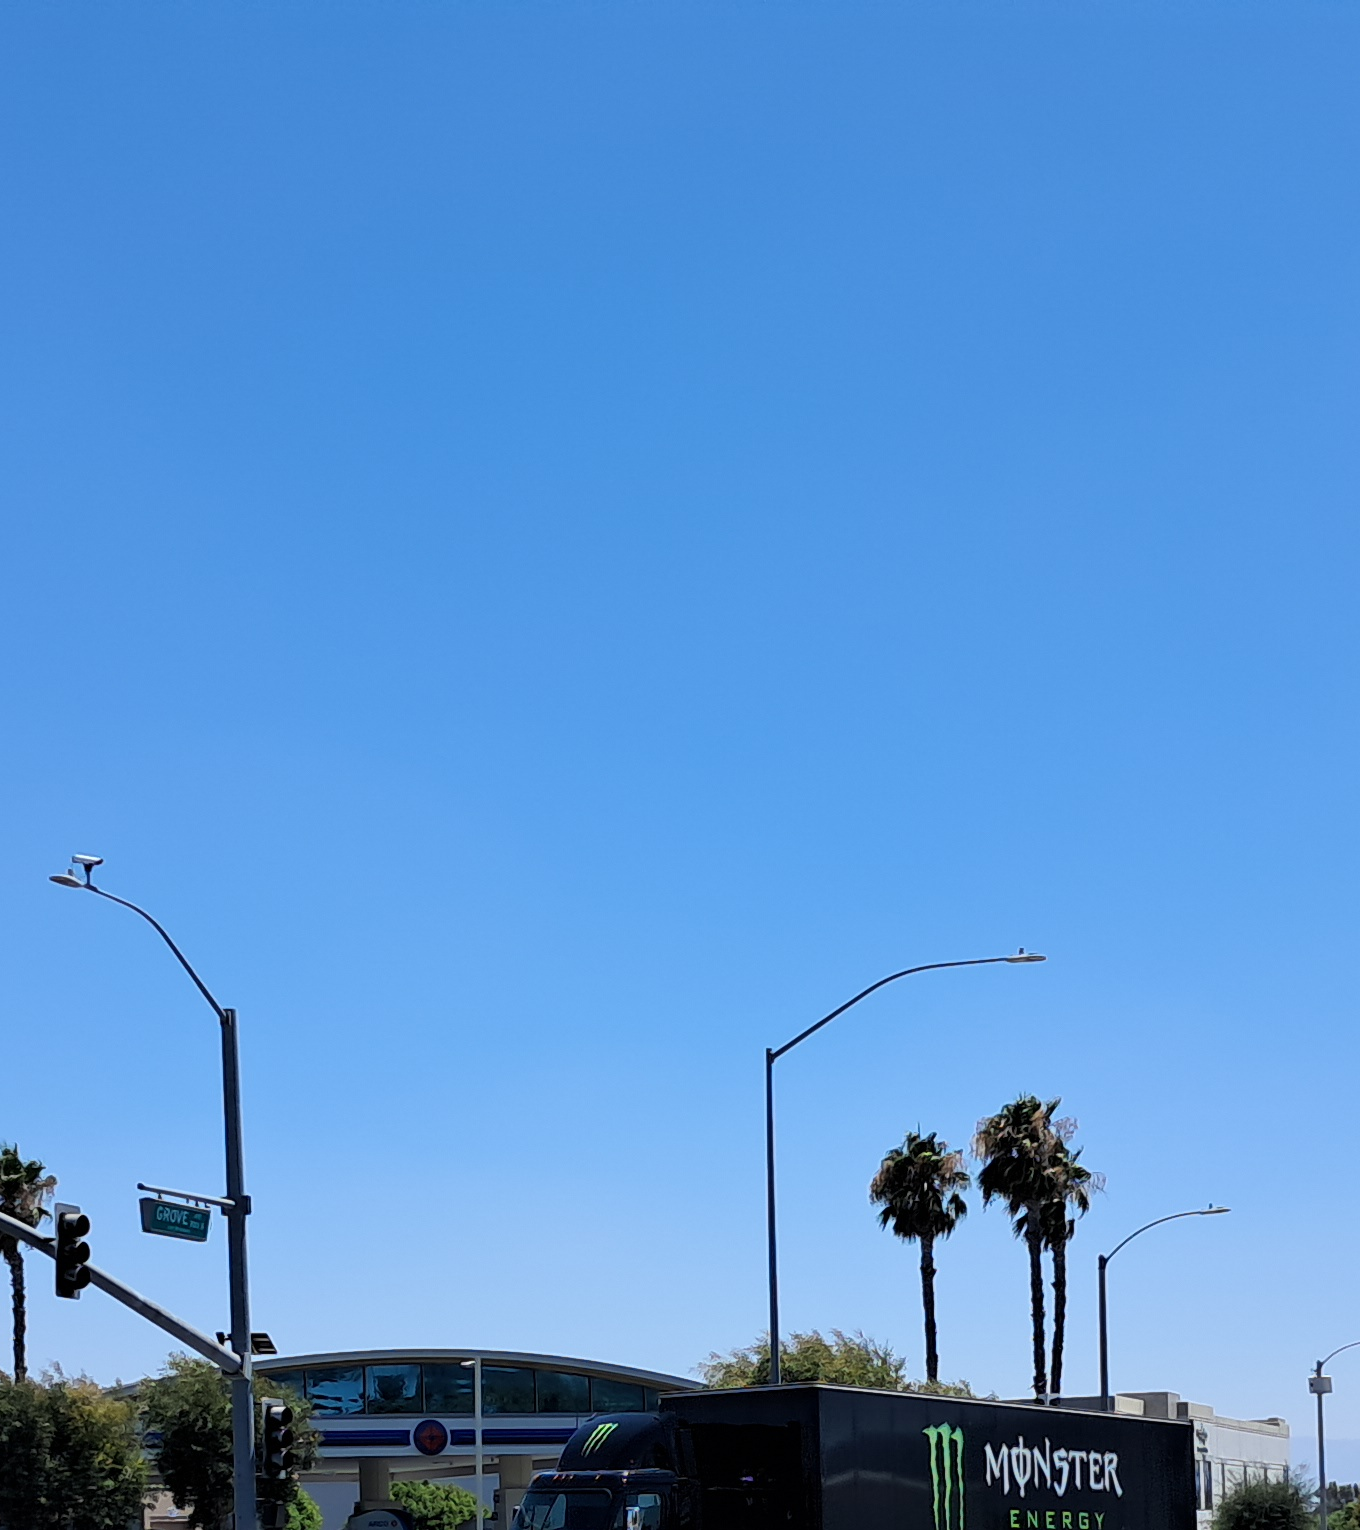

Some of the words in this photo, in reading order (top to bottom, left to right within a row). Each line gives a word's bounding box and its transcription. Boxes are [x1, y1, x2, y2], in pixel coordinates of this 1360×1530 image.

[156, 1205, 190, 1226] GROVE
[984, 1436, 1123, 1498] MONSTER
[368, 1519, 389, 1528] ARCO
[1009, 1509, 1106, 1530] ENERGY
